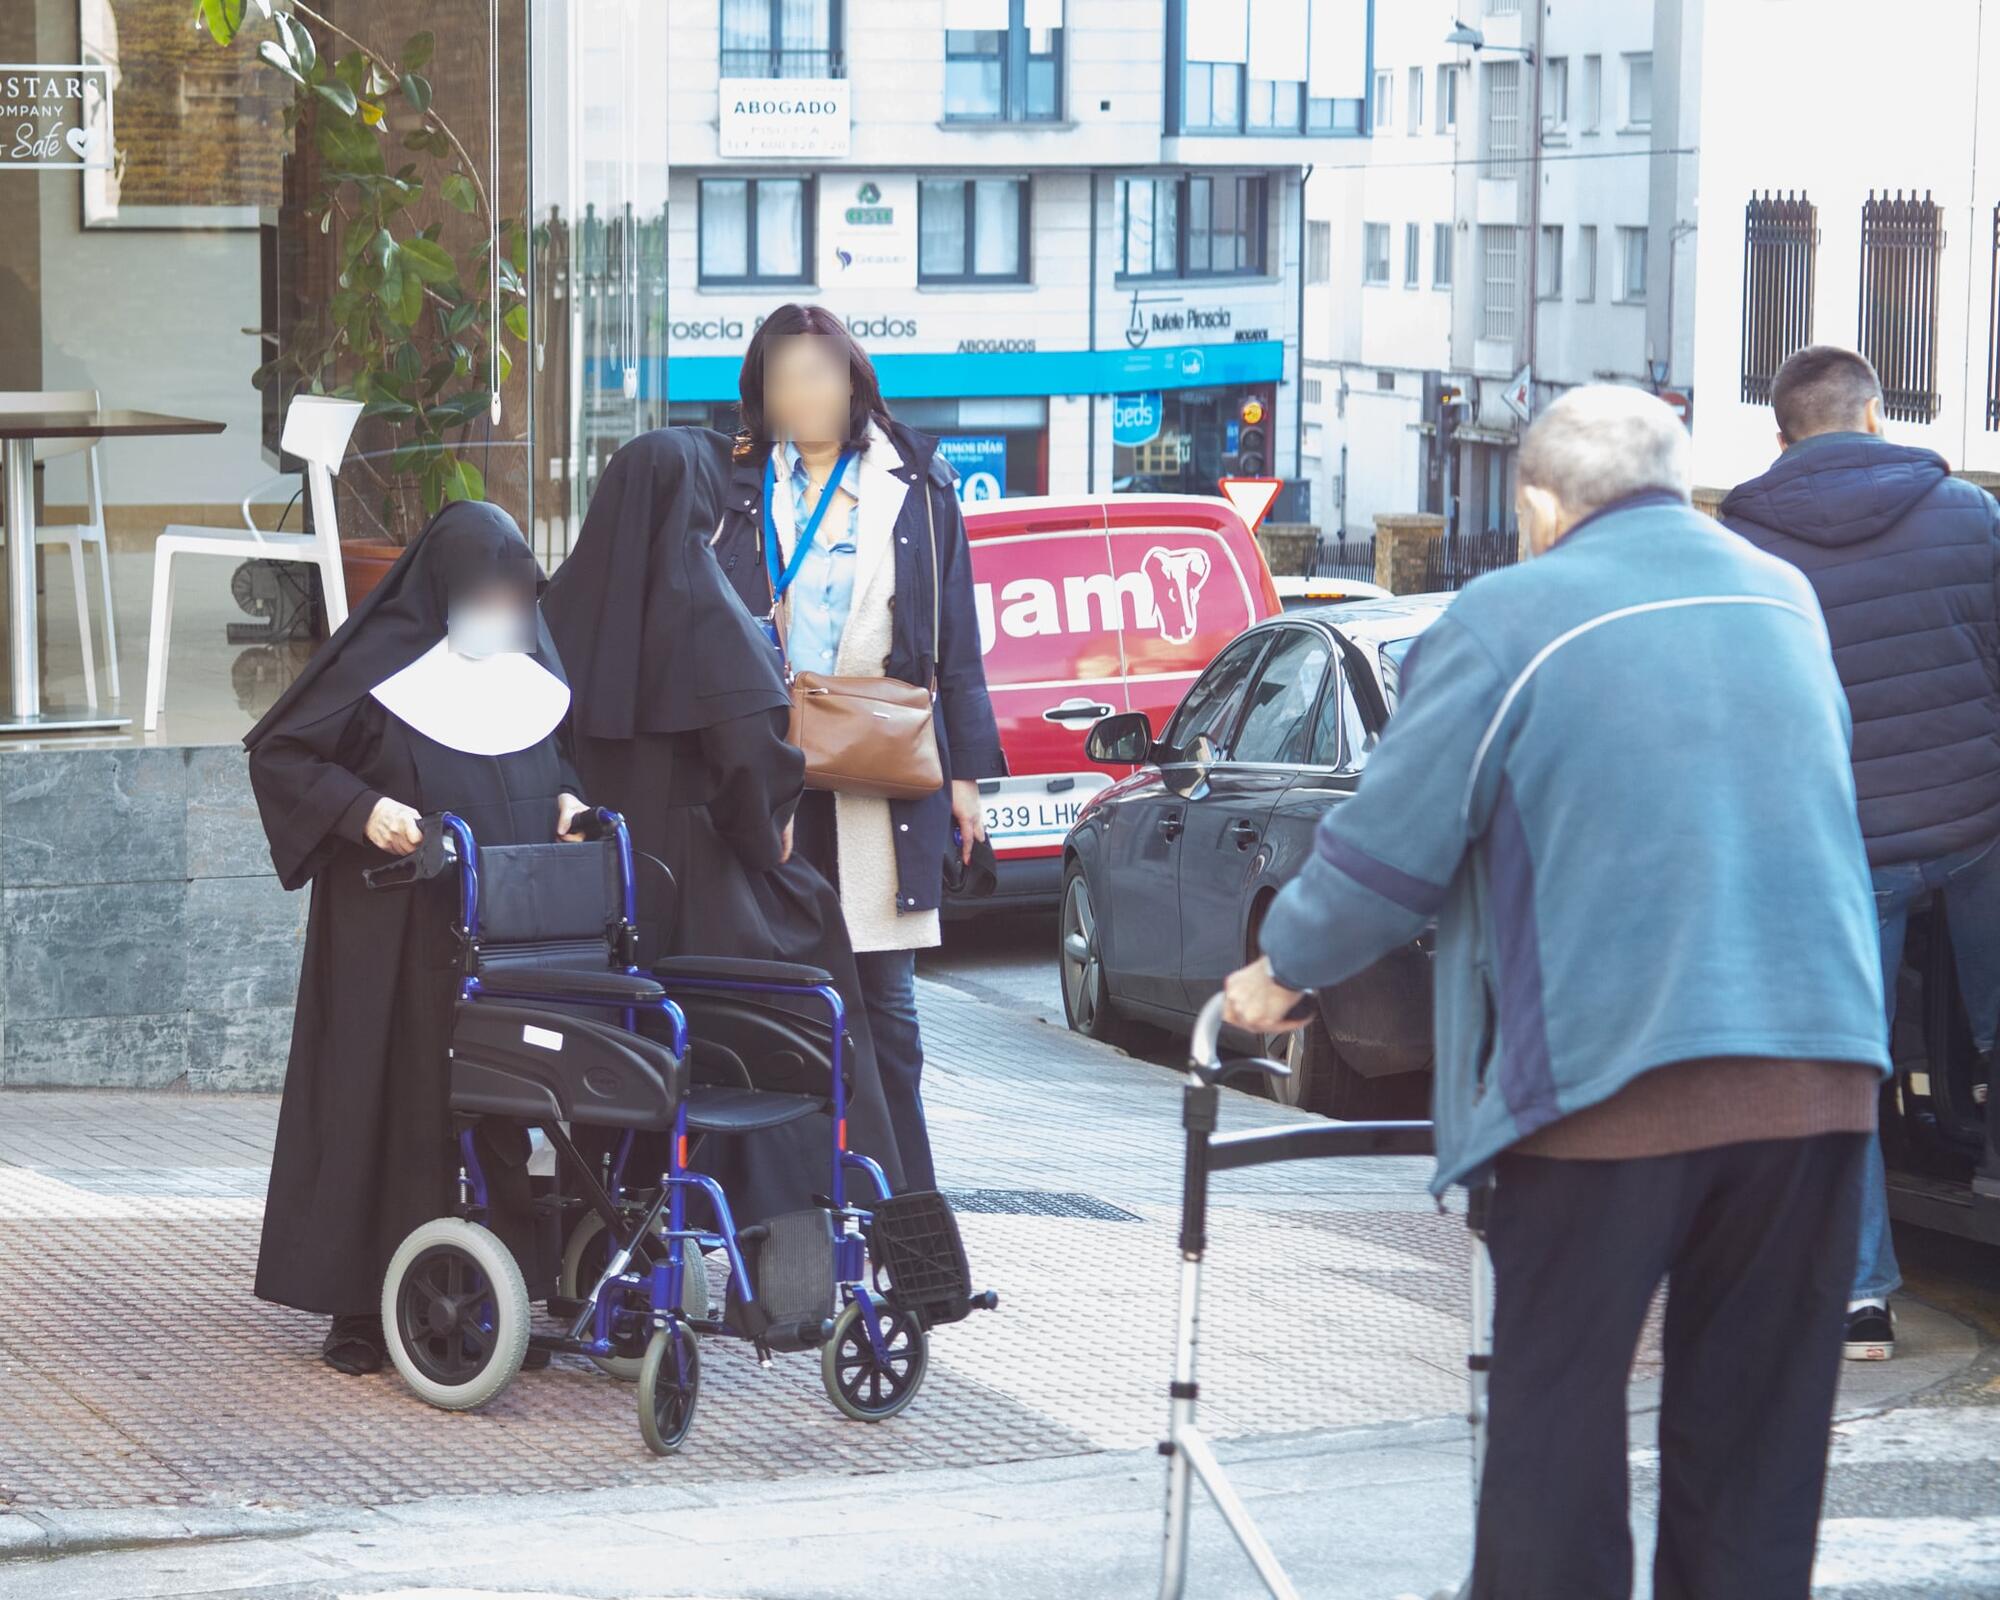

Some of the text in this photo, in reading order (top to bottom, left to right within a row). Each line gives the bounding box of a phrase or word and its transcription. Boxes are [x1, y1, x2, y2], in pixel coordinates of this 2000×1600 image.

[0, 77, 98, 98] STARS
[734, 101, 836, 114] ABOGADO
[11, 121, 63, 158] Safe
[667, 316, 743, 340] oscia
[957, 340, 1036, 353] ABOGADOS
[1114, 394, 1152, 428] beds
[986, 801, 1082, 829] 339 LHK
